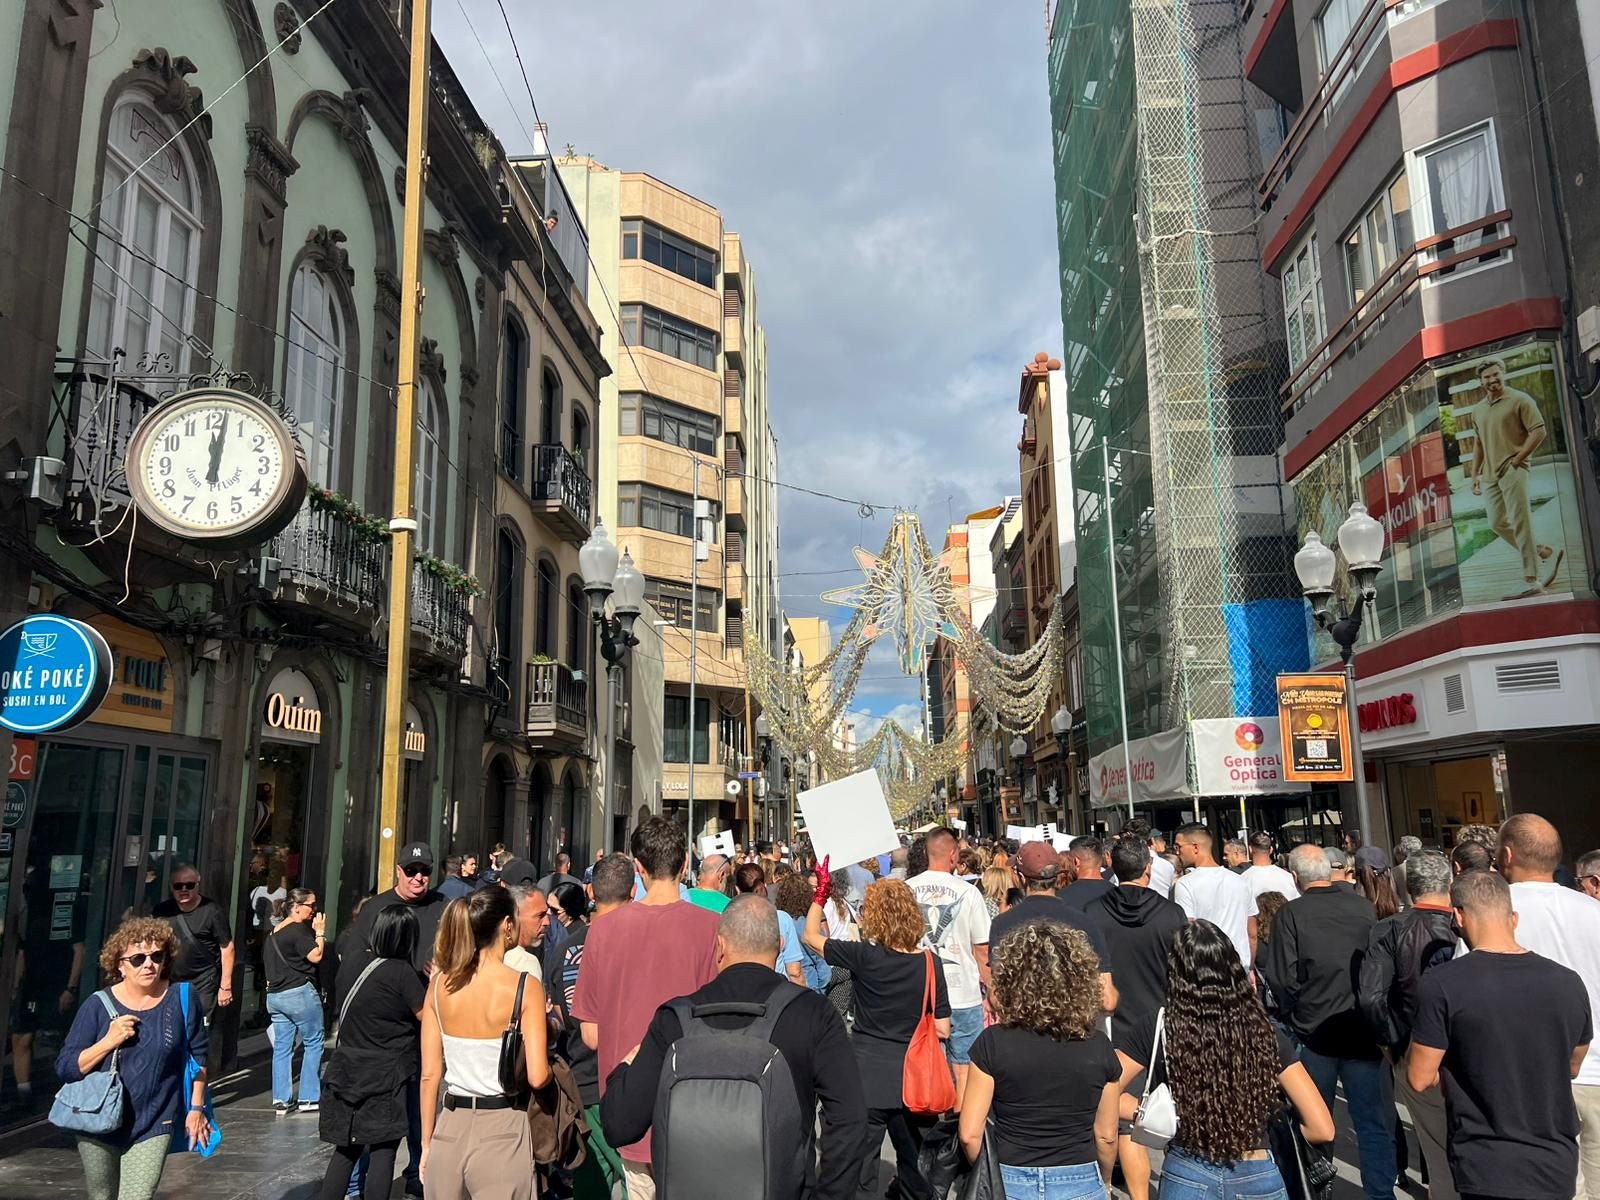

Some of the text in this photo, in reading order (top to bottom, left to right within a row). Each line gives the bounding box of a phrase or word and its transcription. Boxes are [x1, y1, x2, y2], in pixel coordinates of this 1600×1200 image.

[184, 419, 196, 437] 11
[205, 412, 223, 430] 12
[237, 420, 244, 438] 1
[164, 434, 180, 452] 10
[252, 435, 265, 453] 2
[159, 456, 172, 476] 9
[258, 456, 270, 475] 3
[162, 479, 176, 497] 8
[249, 479, 262, 497] 4
[183, 496, 196, 514] 7
[206, 501, 218, 520] 6
[231, 496, 243, 514] 5
[40, 663, 85, 689] POKÉ
[3, 694, 67, 707] SUSHI EN BOL
[1224, 754, 1281, 768] General
[1230, 767, 1277, 783] Optica
